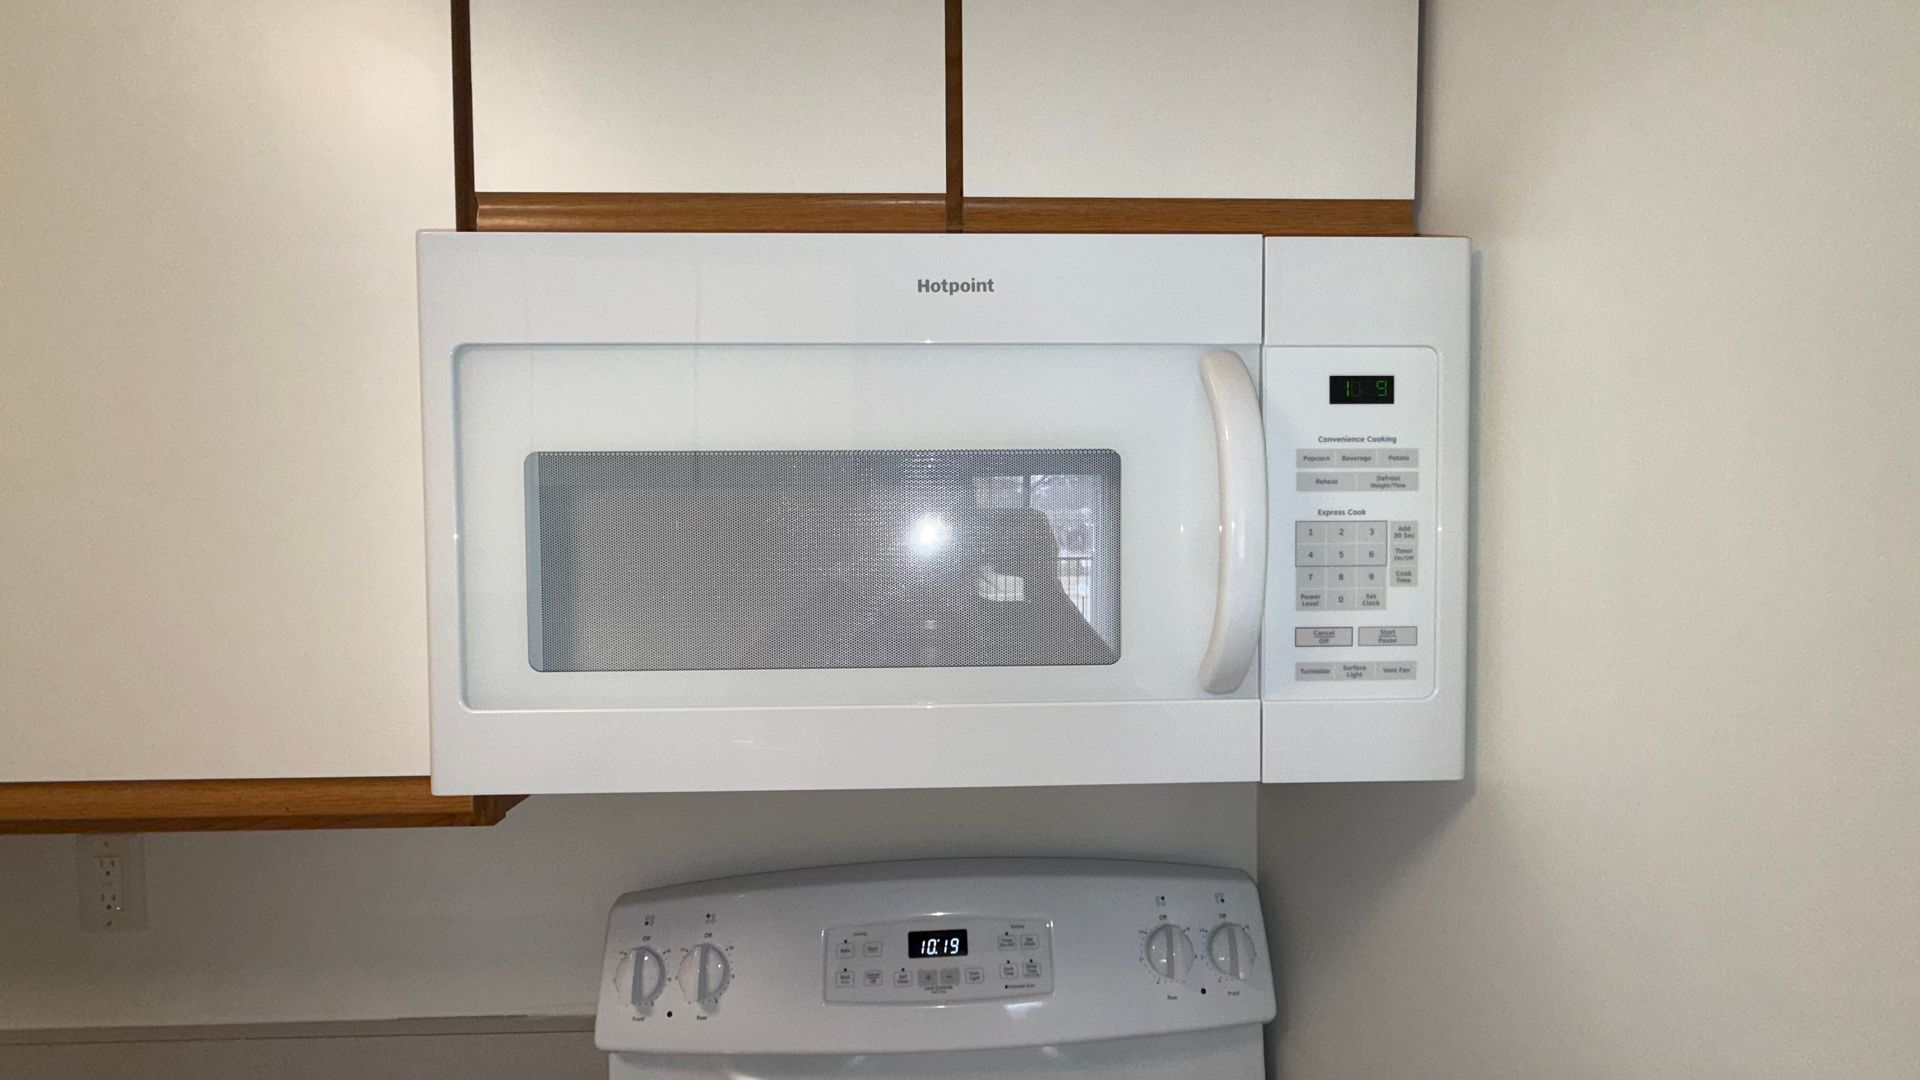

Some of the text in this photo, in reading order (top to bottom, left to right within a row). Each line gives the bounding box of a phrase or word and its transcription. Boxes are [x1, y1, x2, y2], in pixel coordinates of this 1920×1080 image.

[917, 277, 995, 296] Hotpoint
[1318, 435, 1397, 444] Convenience Cooking
[1317, 509, 1346, 517] Express
[1308, 528, 1313, 536] 1
[1339, 528, 1344, 536] 2
[1369, 528, 1374, 536] 3
[1308, 573, 1313, 581] 7
[1338, 573, 1344, 581] 8
[921, 938, 959, 955] 10:19
